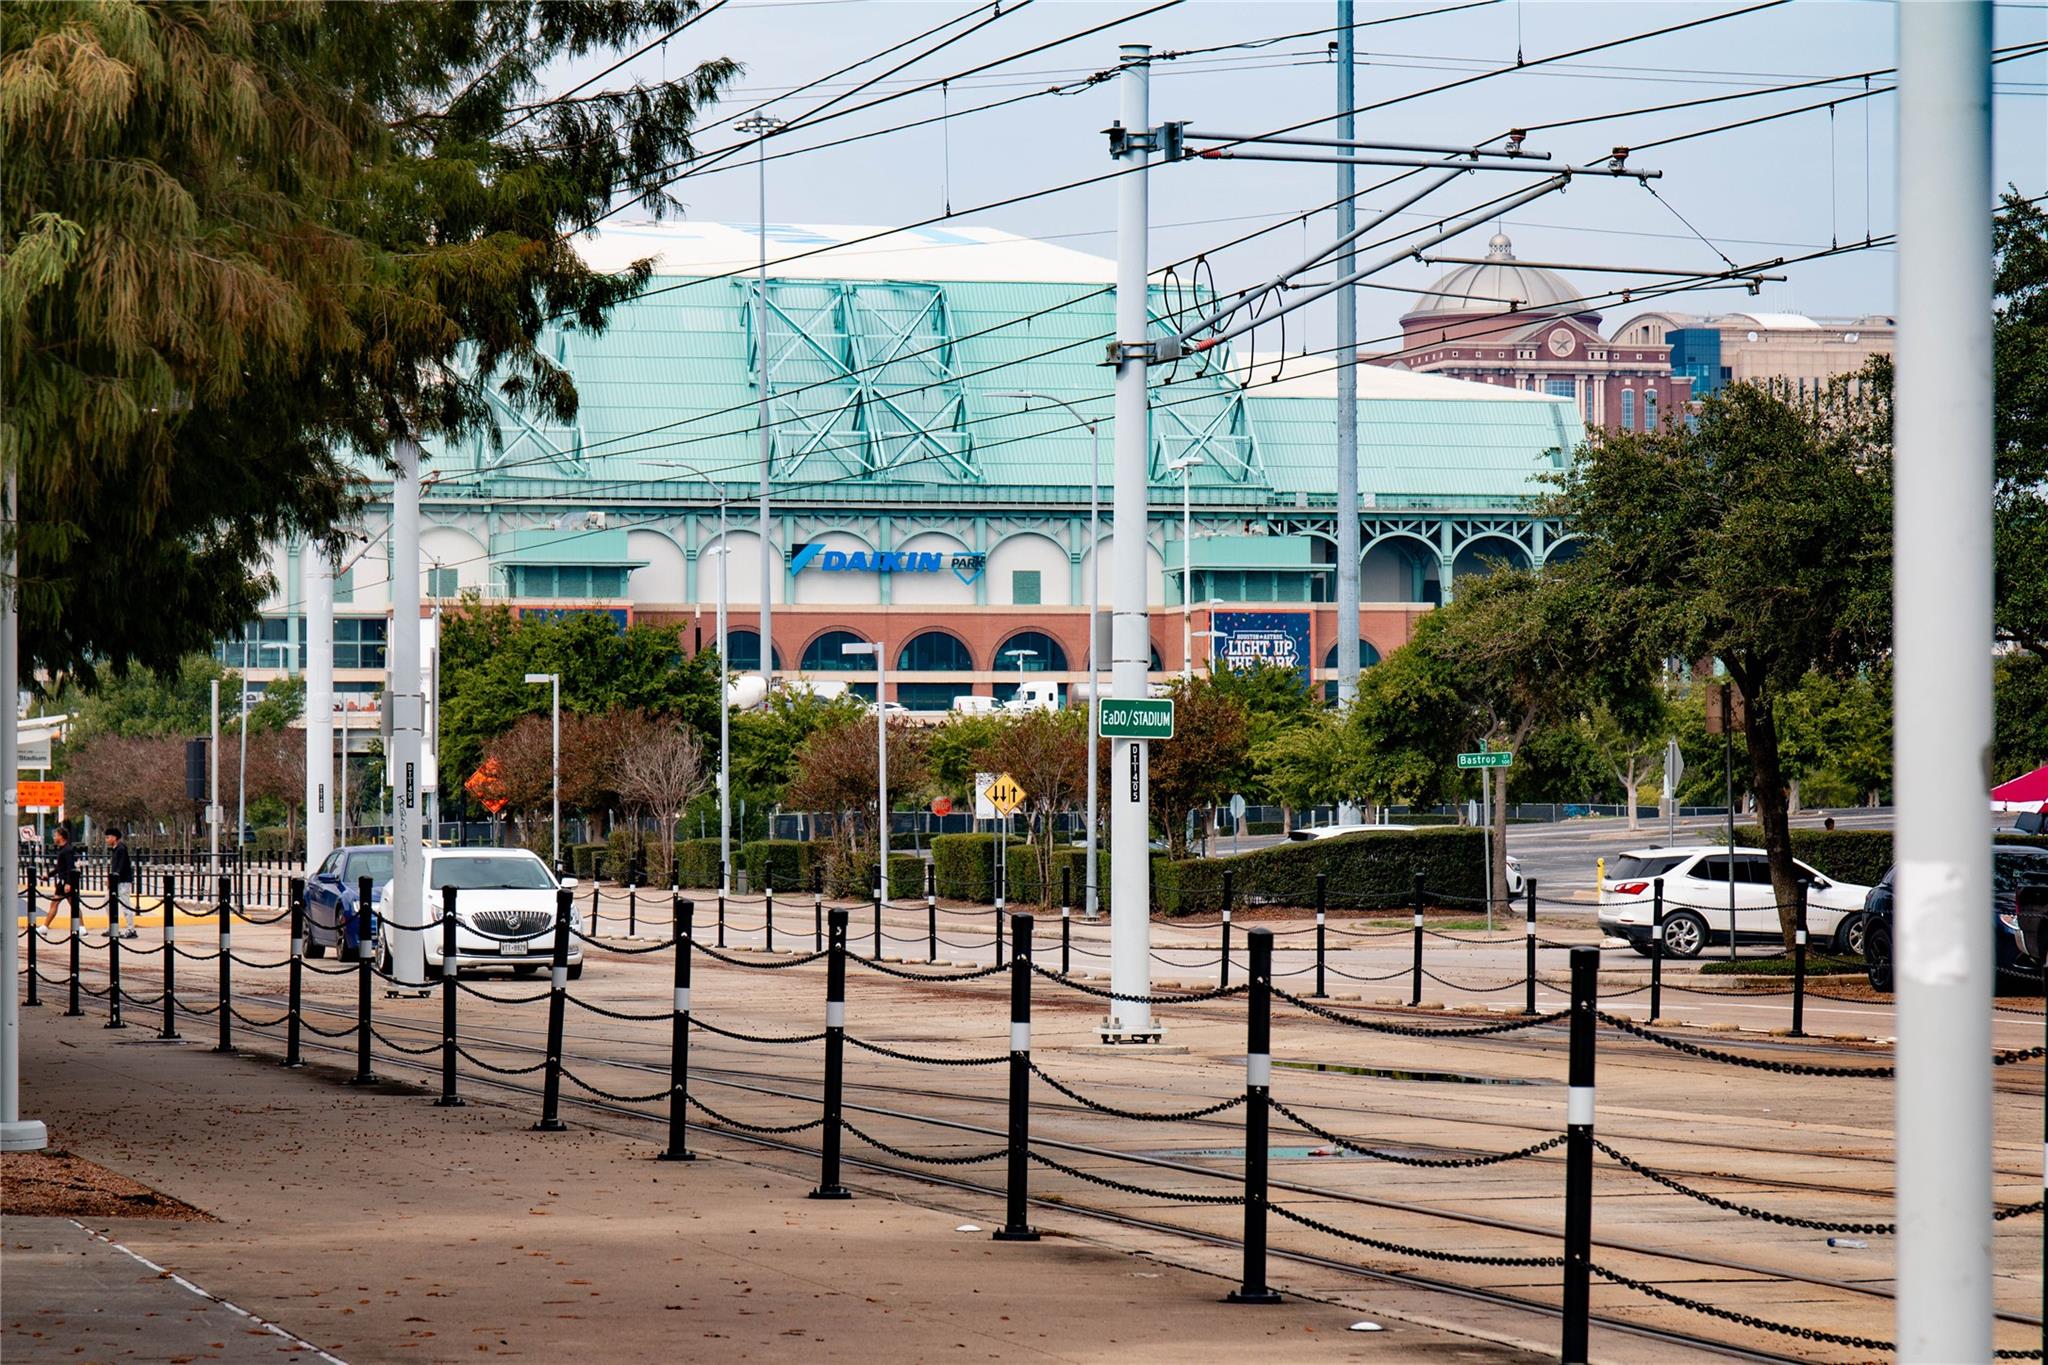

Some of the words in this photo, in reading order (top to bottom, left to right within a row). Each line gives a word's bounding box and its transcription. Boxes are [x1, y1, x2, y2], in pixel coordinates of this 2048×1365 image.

[822, 551, 943, 573] DAIKIN
[951, 558, 985, 569] PARK
[1228, 640, 1270, 655] LIGHT
[1274, 640, 1293, 655] UP
[1102, 709, 1171, 727] EaDO/STADIUM
[1460, 755, 1497, 765] Bastrop
